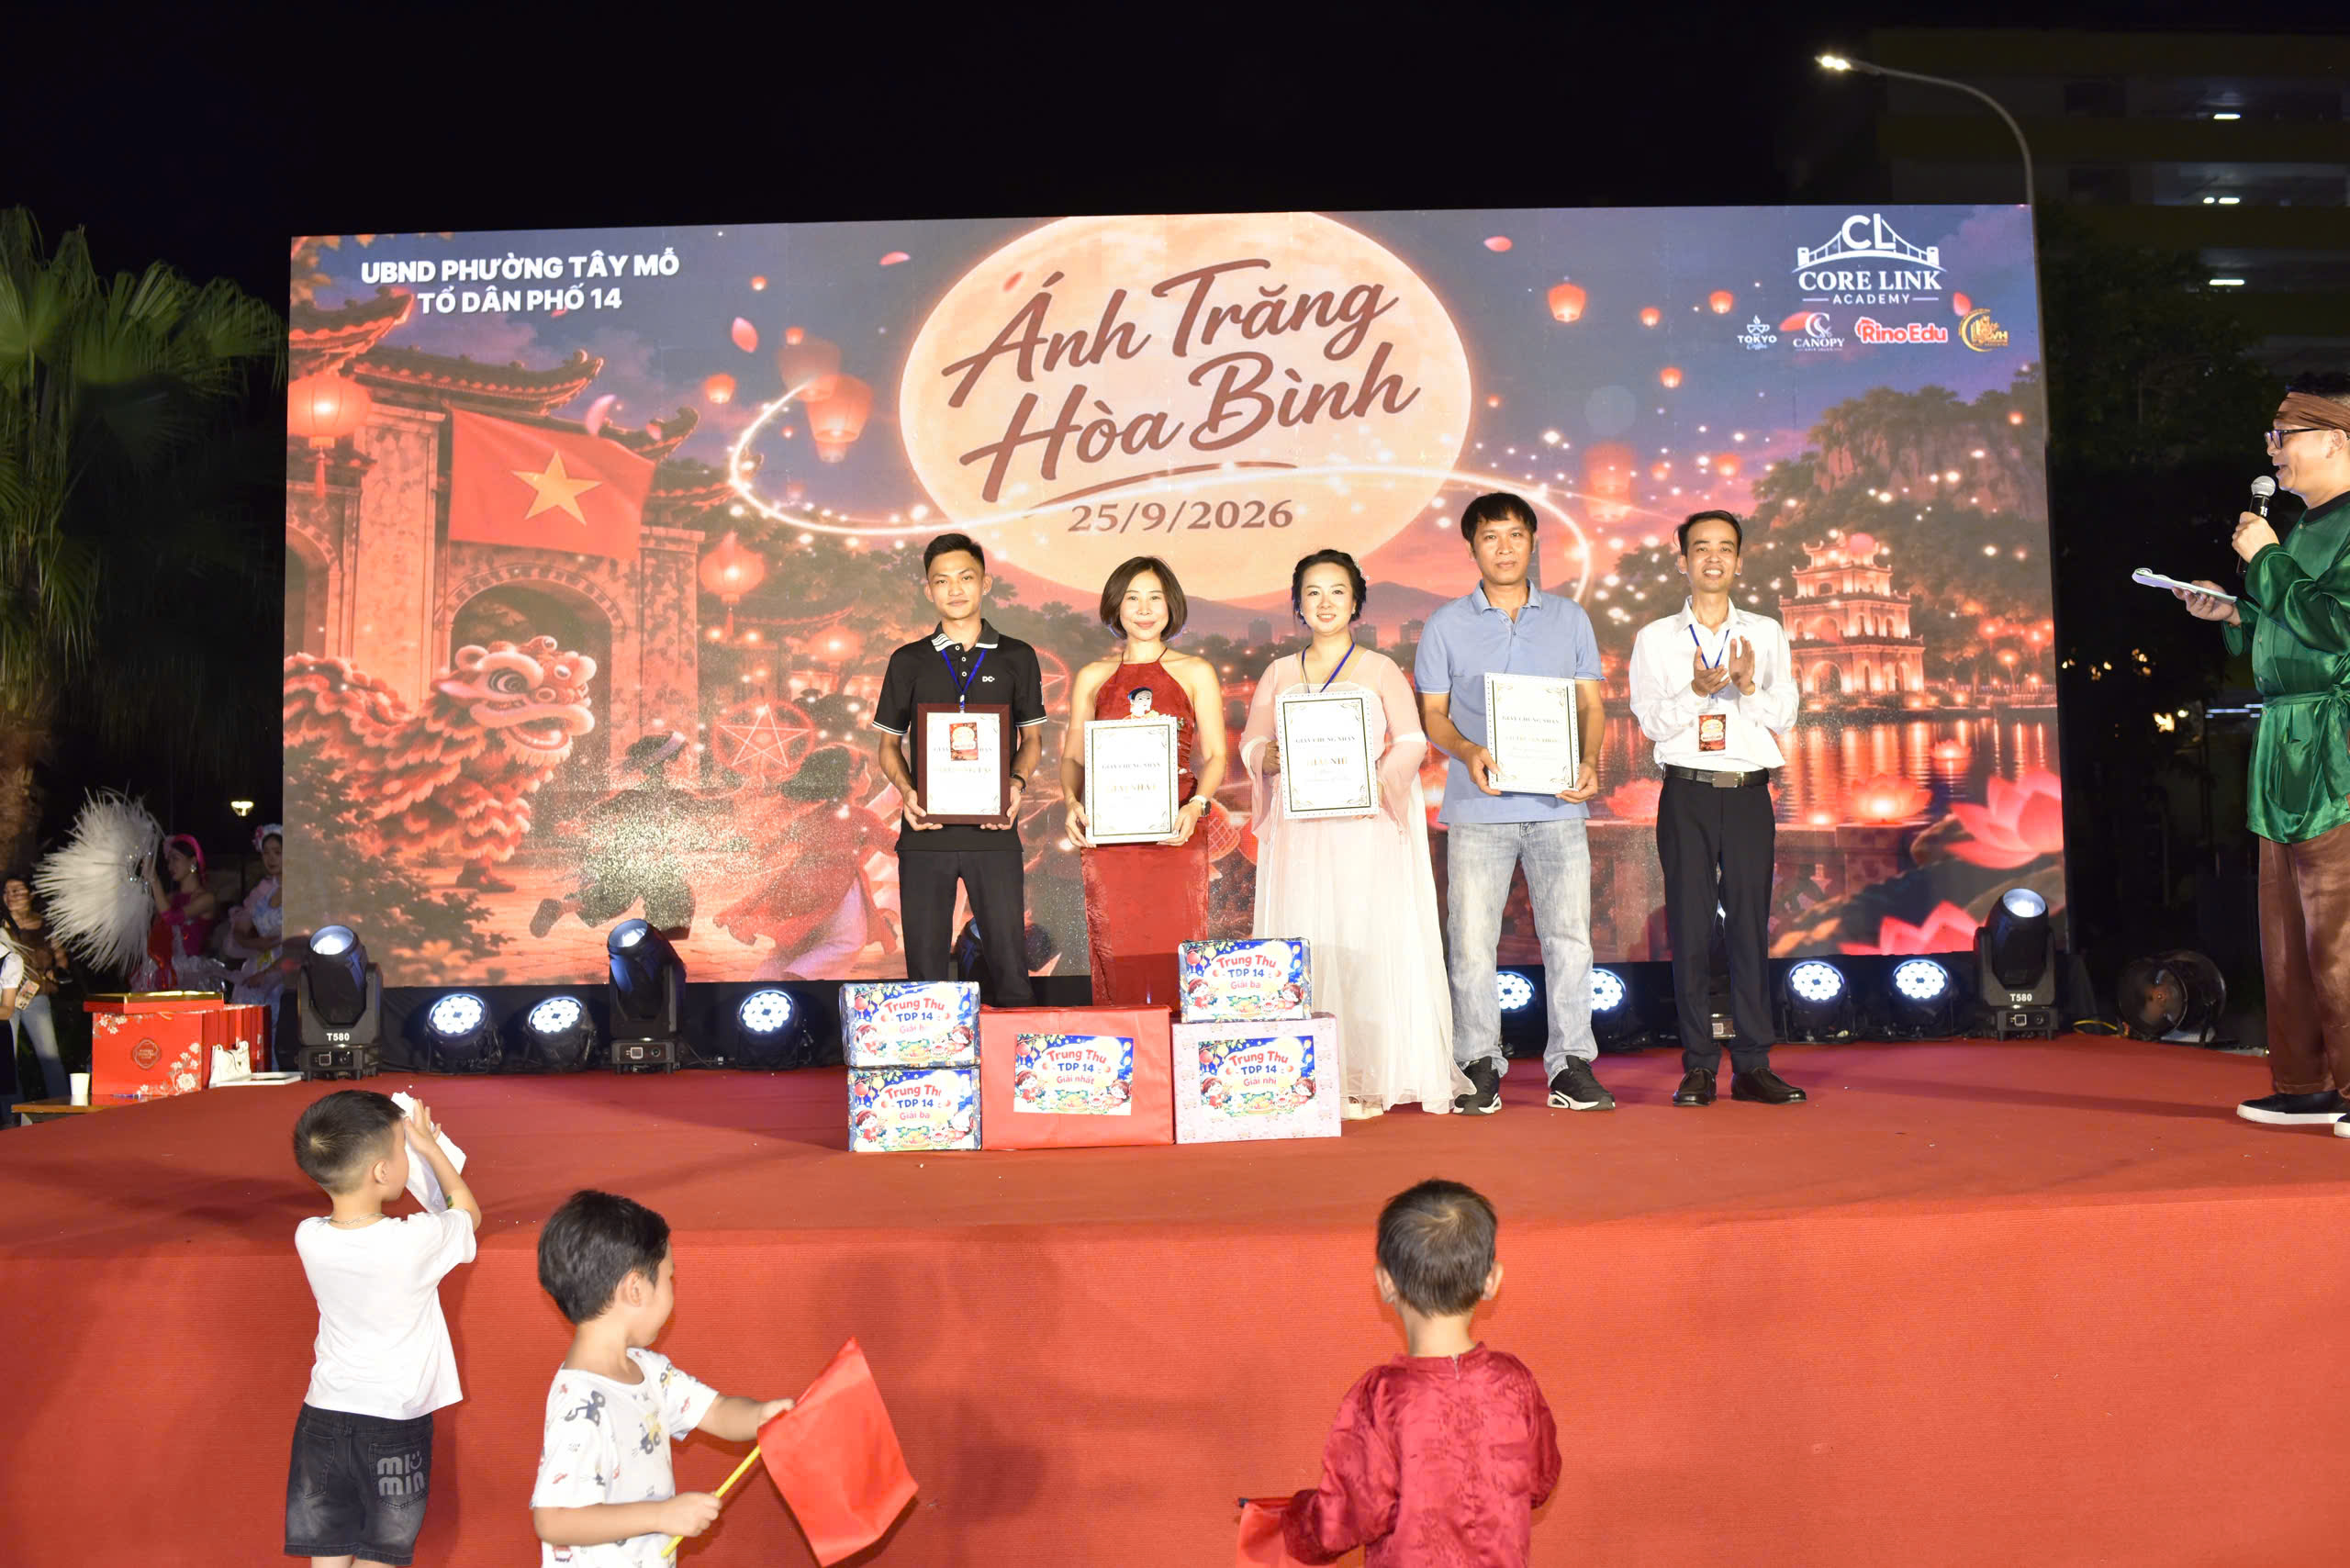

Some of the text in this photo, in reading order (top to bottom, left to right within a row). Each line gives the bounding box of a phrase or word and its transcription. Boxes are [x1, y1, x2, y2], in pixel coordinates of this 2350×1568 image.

[1841, 213, 1897, 250] CL
[361, 247, 679, 284] UBND PHƯỜNG TÂY MỖ
[1798, 270, 1942, 291] CORE LINK
[417, 282, 622, 314] TỔ DÂN PHỐ 14
[1832, 294, 1910, 304] ACADEMY
[941, 259, 1398, 408] Ánh Trăng
[1737, 334, 1777, 343] TOKYO
[1793, 338, 1844, 348] CANOPY
[959, 342, 1420, 503] Hòa Bình
[1068, 499, 1292, 533] 25/9/2026
[1216, 955, 1277, 969] Trung Thu
[1227, 969, 1264, 978] TDP 14
[1250, 980, 1261, 989] ba
[2009, 993, 2032, 1002] T580
[884, 998, 946, 1014] Trung Thu
[896, 1012, 934, 1022] TDP 14
[327, 1033, 350, 1041] T580
[1046, 1049, 1106, 1064] Trung Thu
[1228, 1050, 1289, 1066] Trung Thu
[1058, 1063, 1094, 1072] TDP 14
[1241, 1065, 1277, 1075] TDP 14
[885, 1085, 921, 1100] Trung
[897, 1099, 934, 1108] TDP 14
[920, 1111, 931, 1119] ba
[378, 1471, 425, 1496] min
